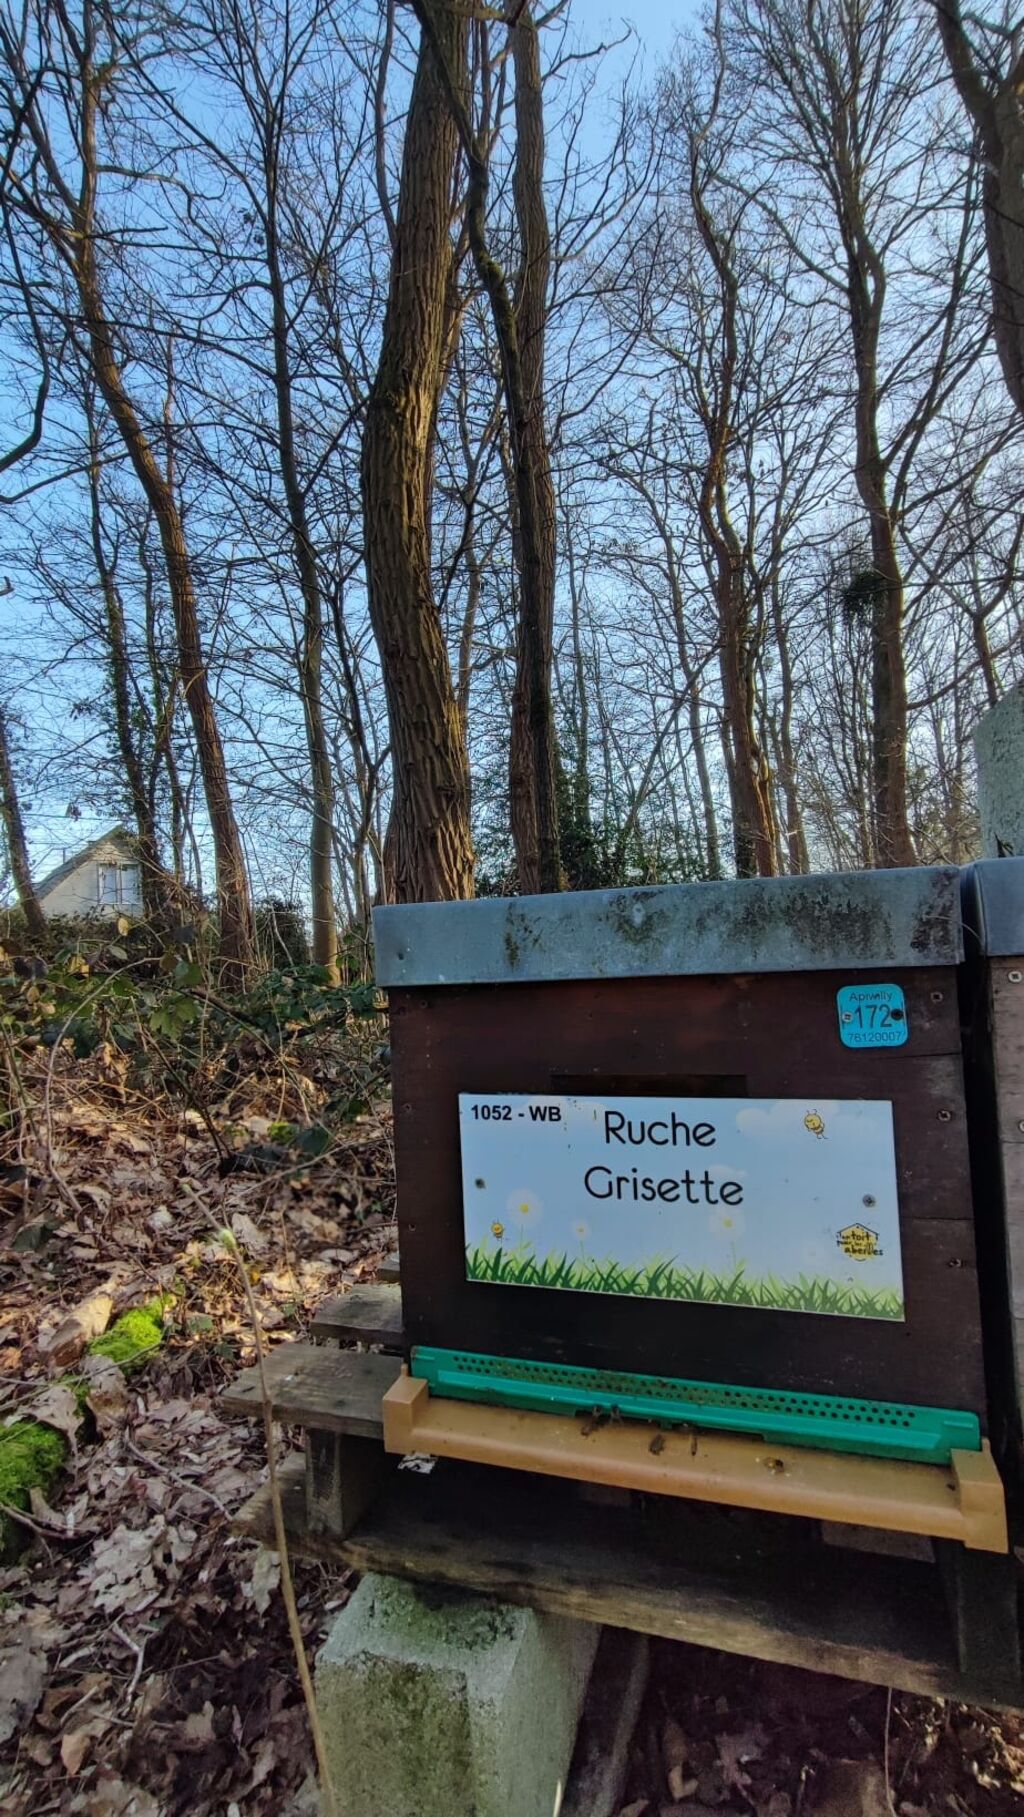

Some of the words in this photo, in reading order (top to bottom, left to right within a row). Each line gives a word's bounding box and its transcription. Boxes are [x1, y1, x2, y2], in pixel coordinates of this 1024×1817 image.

[854, 1003, 893, 1029] 172
[470, 1104, 512, 1121] 1052
[528, 1105, 562, 1122] WB
[604, 1110, 716, 1147] Ruche
[584, 1165, 743, 1206] Grisette
